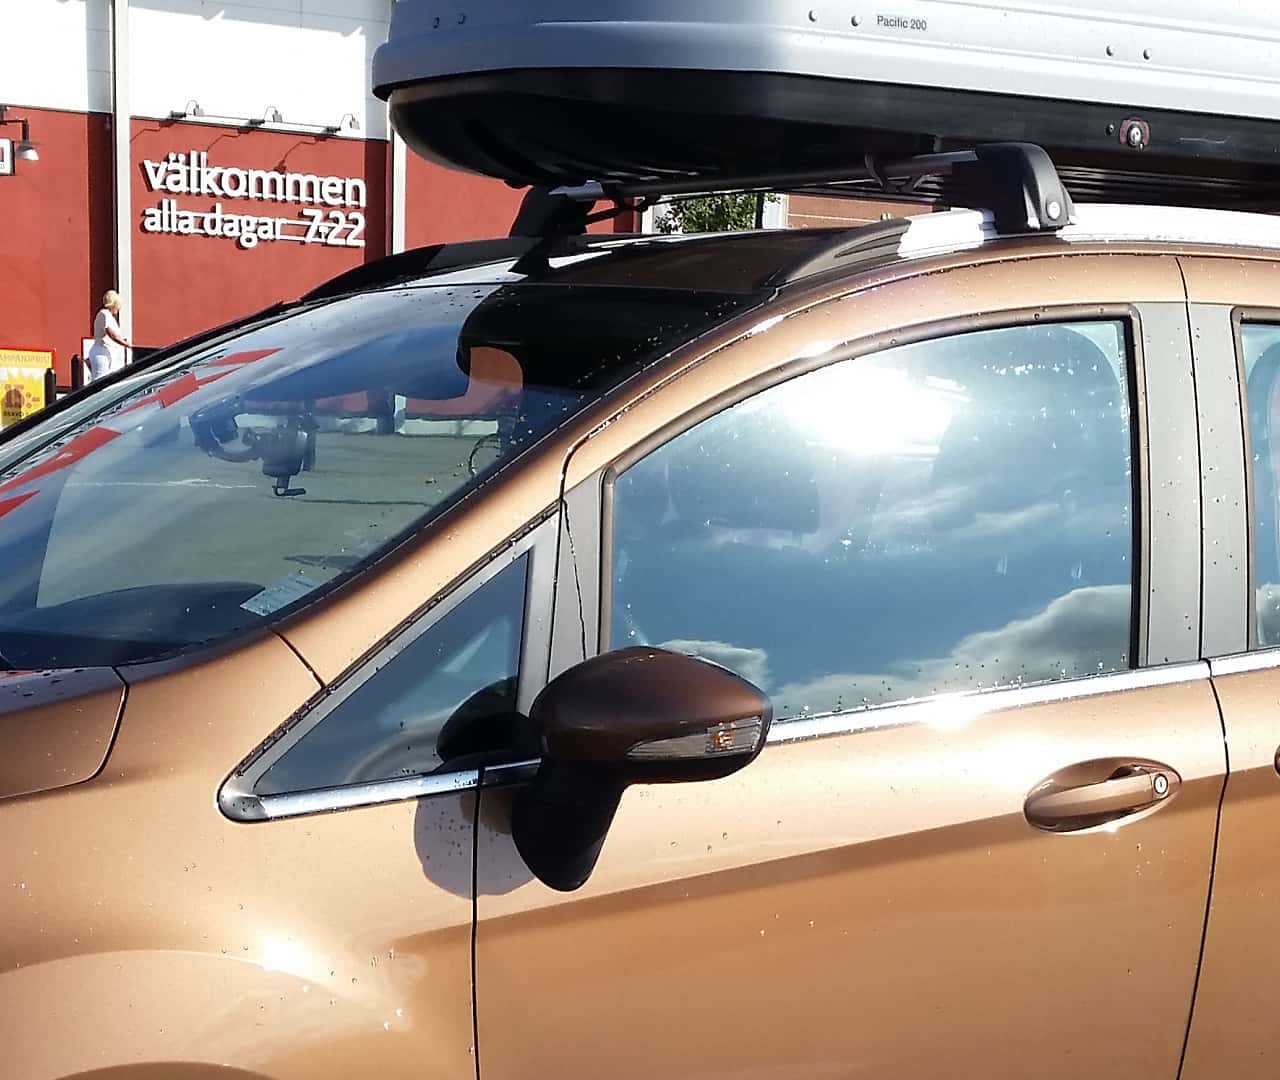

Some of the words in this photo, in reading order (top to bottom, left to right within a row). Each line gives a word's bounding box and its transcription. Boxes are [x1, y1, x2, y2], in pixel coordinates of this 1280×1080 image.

[877, 15, 908, 29] Pacific
[910, 18, 927, 31] 200
[143, 150, 366, 208] välkommen
[144, 199, 195, 234] alla
[202, 203, 287, 248] dagar
